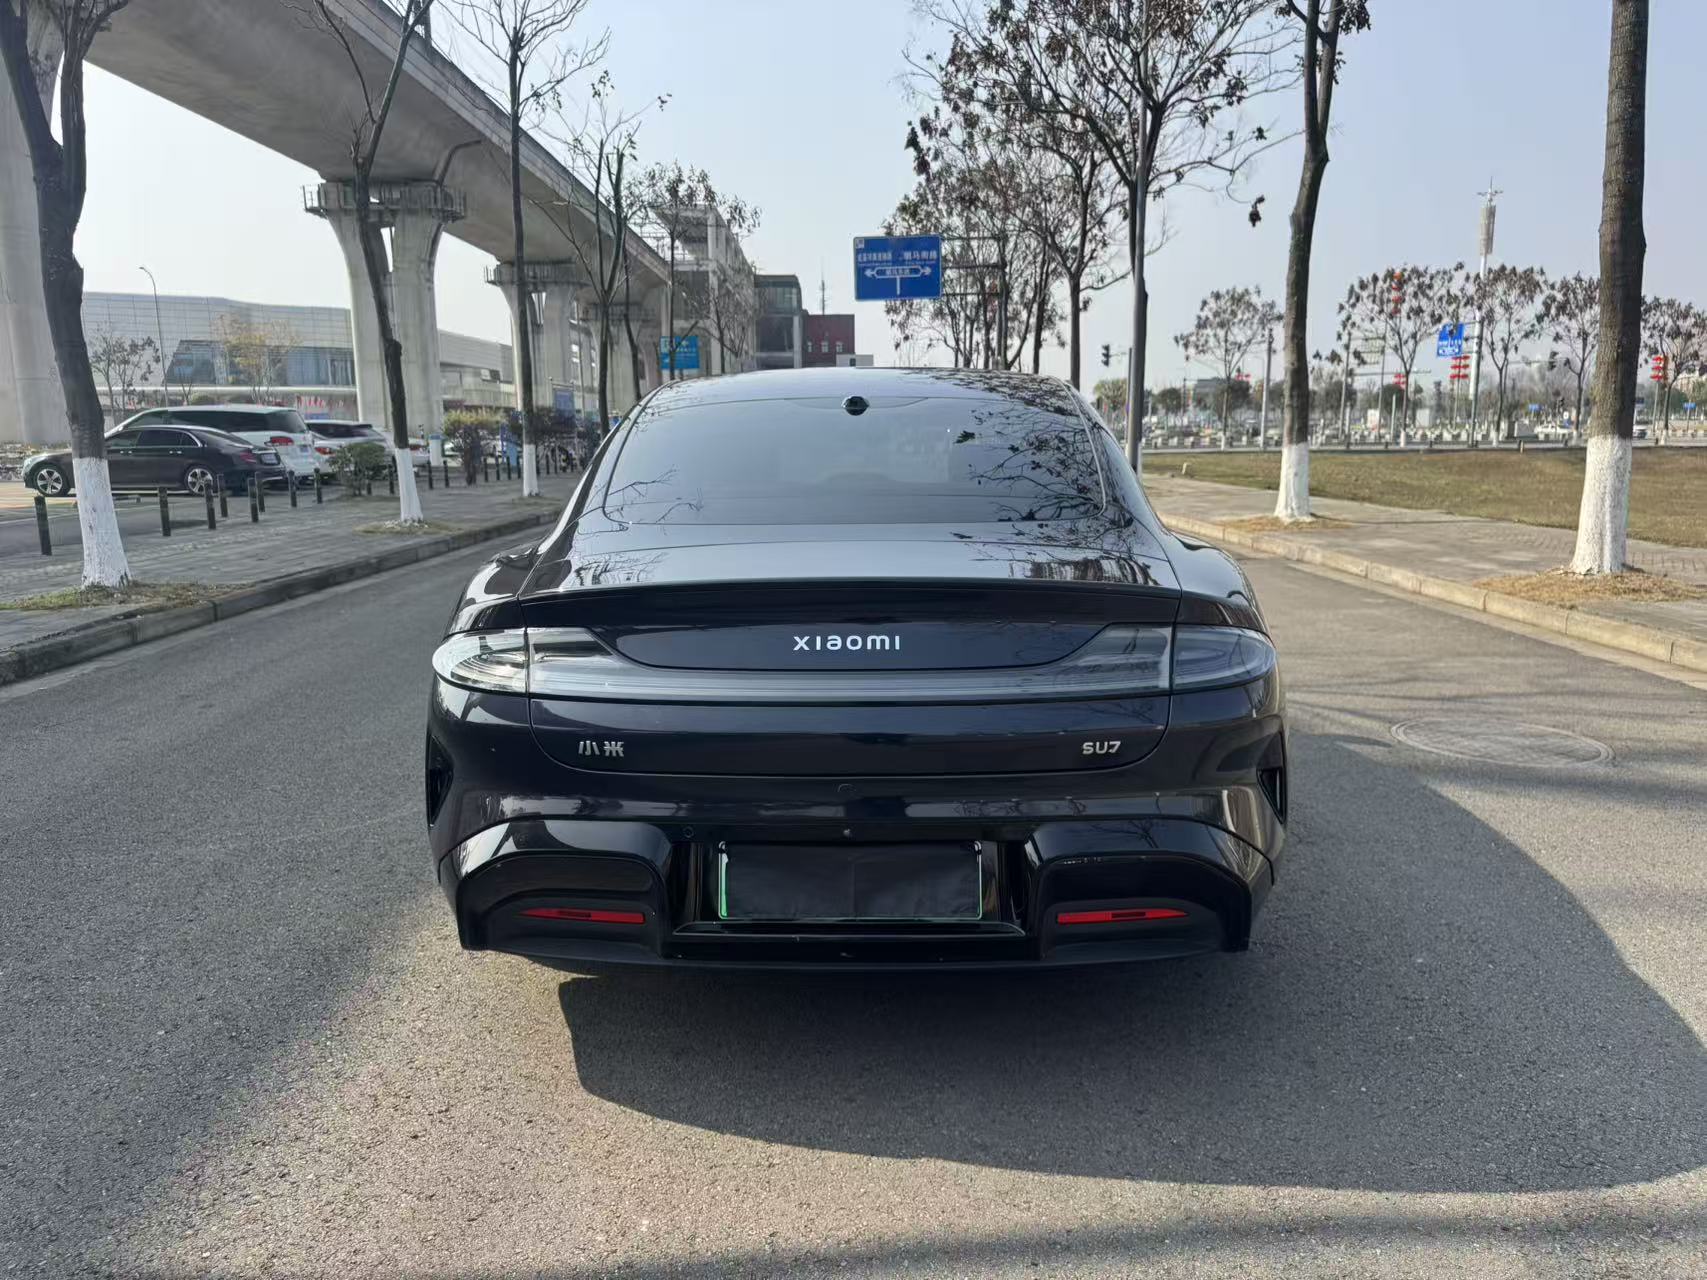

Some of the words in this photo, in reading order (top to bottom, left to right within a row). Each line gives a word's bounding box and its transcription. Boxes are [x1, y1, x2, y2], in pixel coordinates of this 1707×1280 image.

[793, 635, 901, 651] xiaomi
[578, 740, 625, 757] 小米
[1082, 740, 1122, 755] SU7
